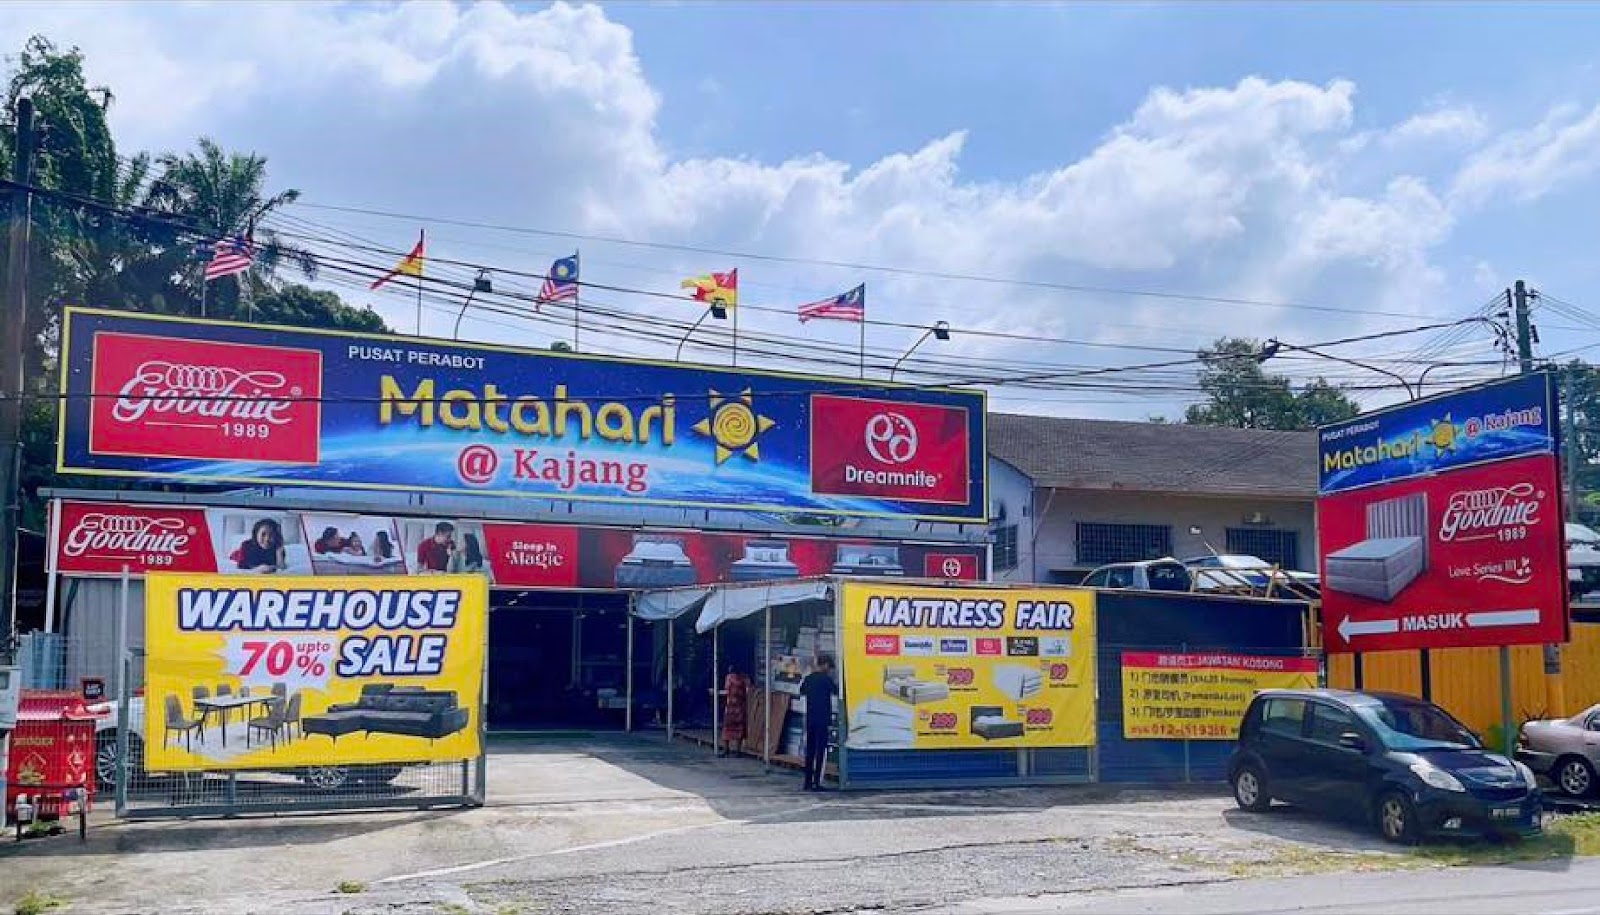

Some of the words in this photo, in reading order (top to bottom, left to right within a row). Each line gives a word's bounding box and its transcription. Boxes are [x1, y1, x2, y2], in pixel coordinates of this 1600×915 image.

[348, 345, 403, 363] PUSAT
[408, 351, 485, 370] PERABOT
[112, 361, 293, 424] Goodnite
[379, 374, 676, 446] Matahari
[221, 422, 270, 438] 1989
[1322, 429, 1344, 441] PUSAT
[1324, 431, 1420, 473] Matahari
[1484, 406, 1542, 431] Kajang
[458, 444, 498, 484] @
[513, 448, 648, 493] Kajang
[845, 465, 937, 488] Dreamnite
[1439, 483, 1540, 541] Goodnite
[63, 513, 189, 556] Goodnite
[1498, 526, 1526, 541] 1989
[512, 541, 544, 553] Sleep
[140, 555, 173, 565] 1989
[505, 551, 564, 569] Magic
[178, 588, 462, 632] WAREHOUSE
[866, 595, 1006, 629] MATTRESS
[1015, 600, 1074, 630] FAIR
[1402, 613, 1464, 632] MASUK
[297, 640, 330, 654] upto
[336, 634, 447, 677] SALE
[1242, 659, 1284, 670] KOSONG
